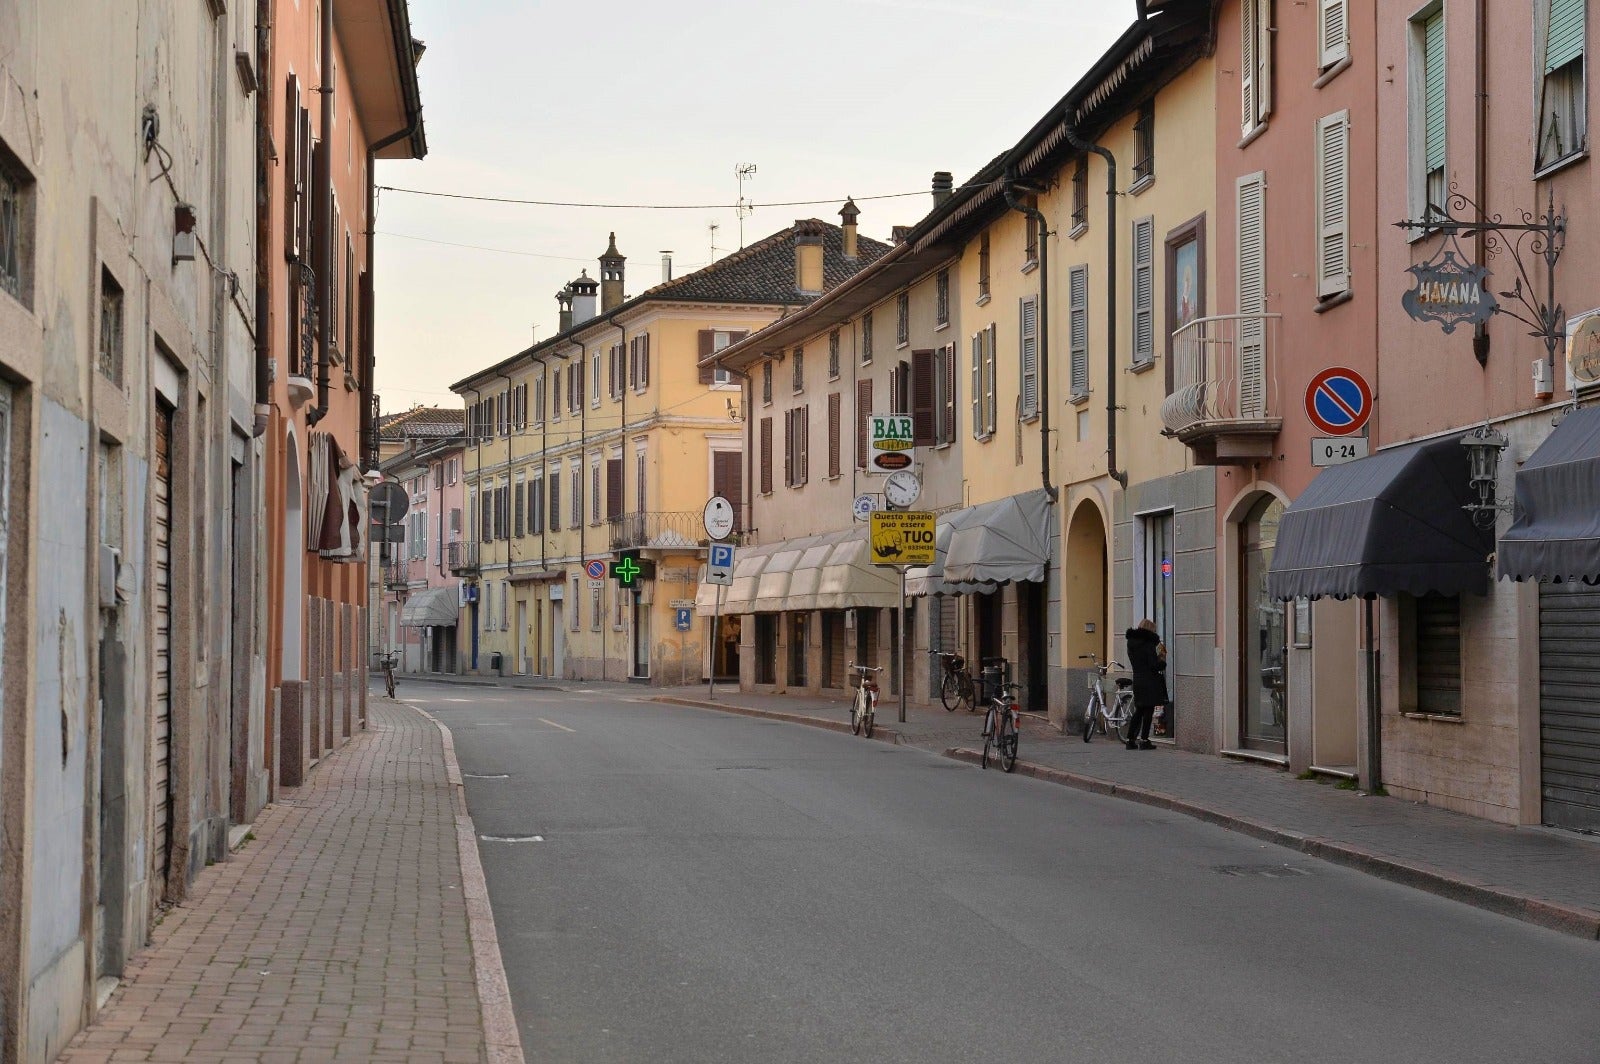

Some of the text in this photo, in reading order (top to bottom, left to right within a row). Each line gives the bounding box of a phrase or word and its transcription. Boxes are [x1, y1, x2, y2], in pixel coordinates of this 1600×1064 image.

[1420, 281, 1480, 304] HAVANA
[873, 418, 913, 438] BAR
[1325, 445, 1356, 458] 0-24
[907, 514, 932, 522] spazio
[903, 531, 933, 543] TUO
[714, 548, 728, 564] P
[682, 611, 686, 619] P
